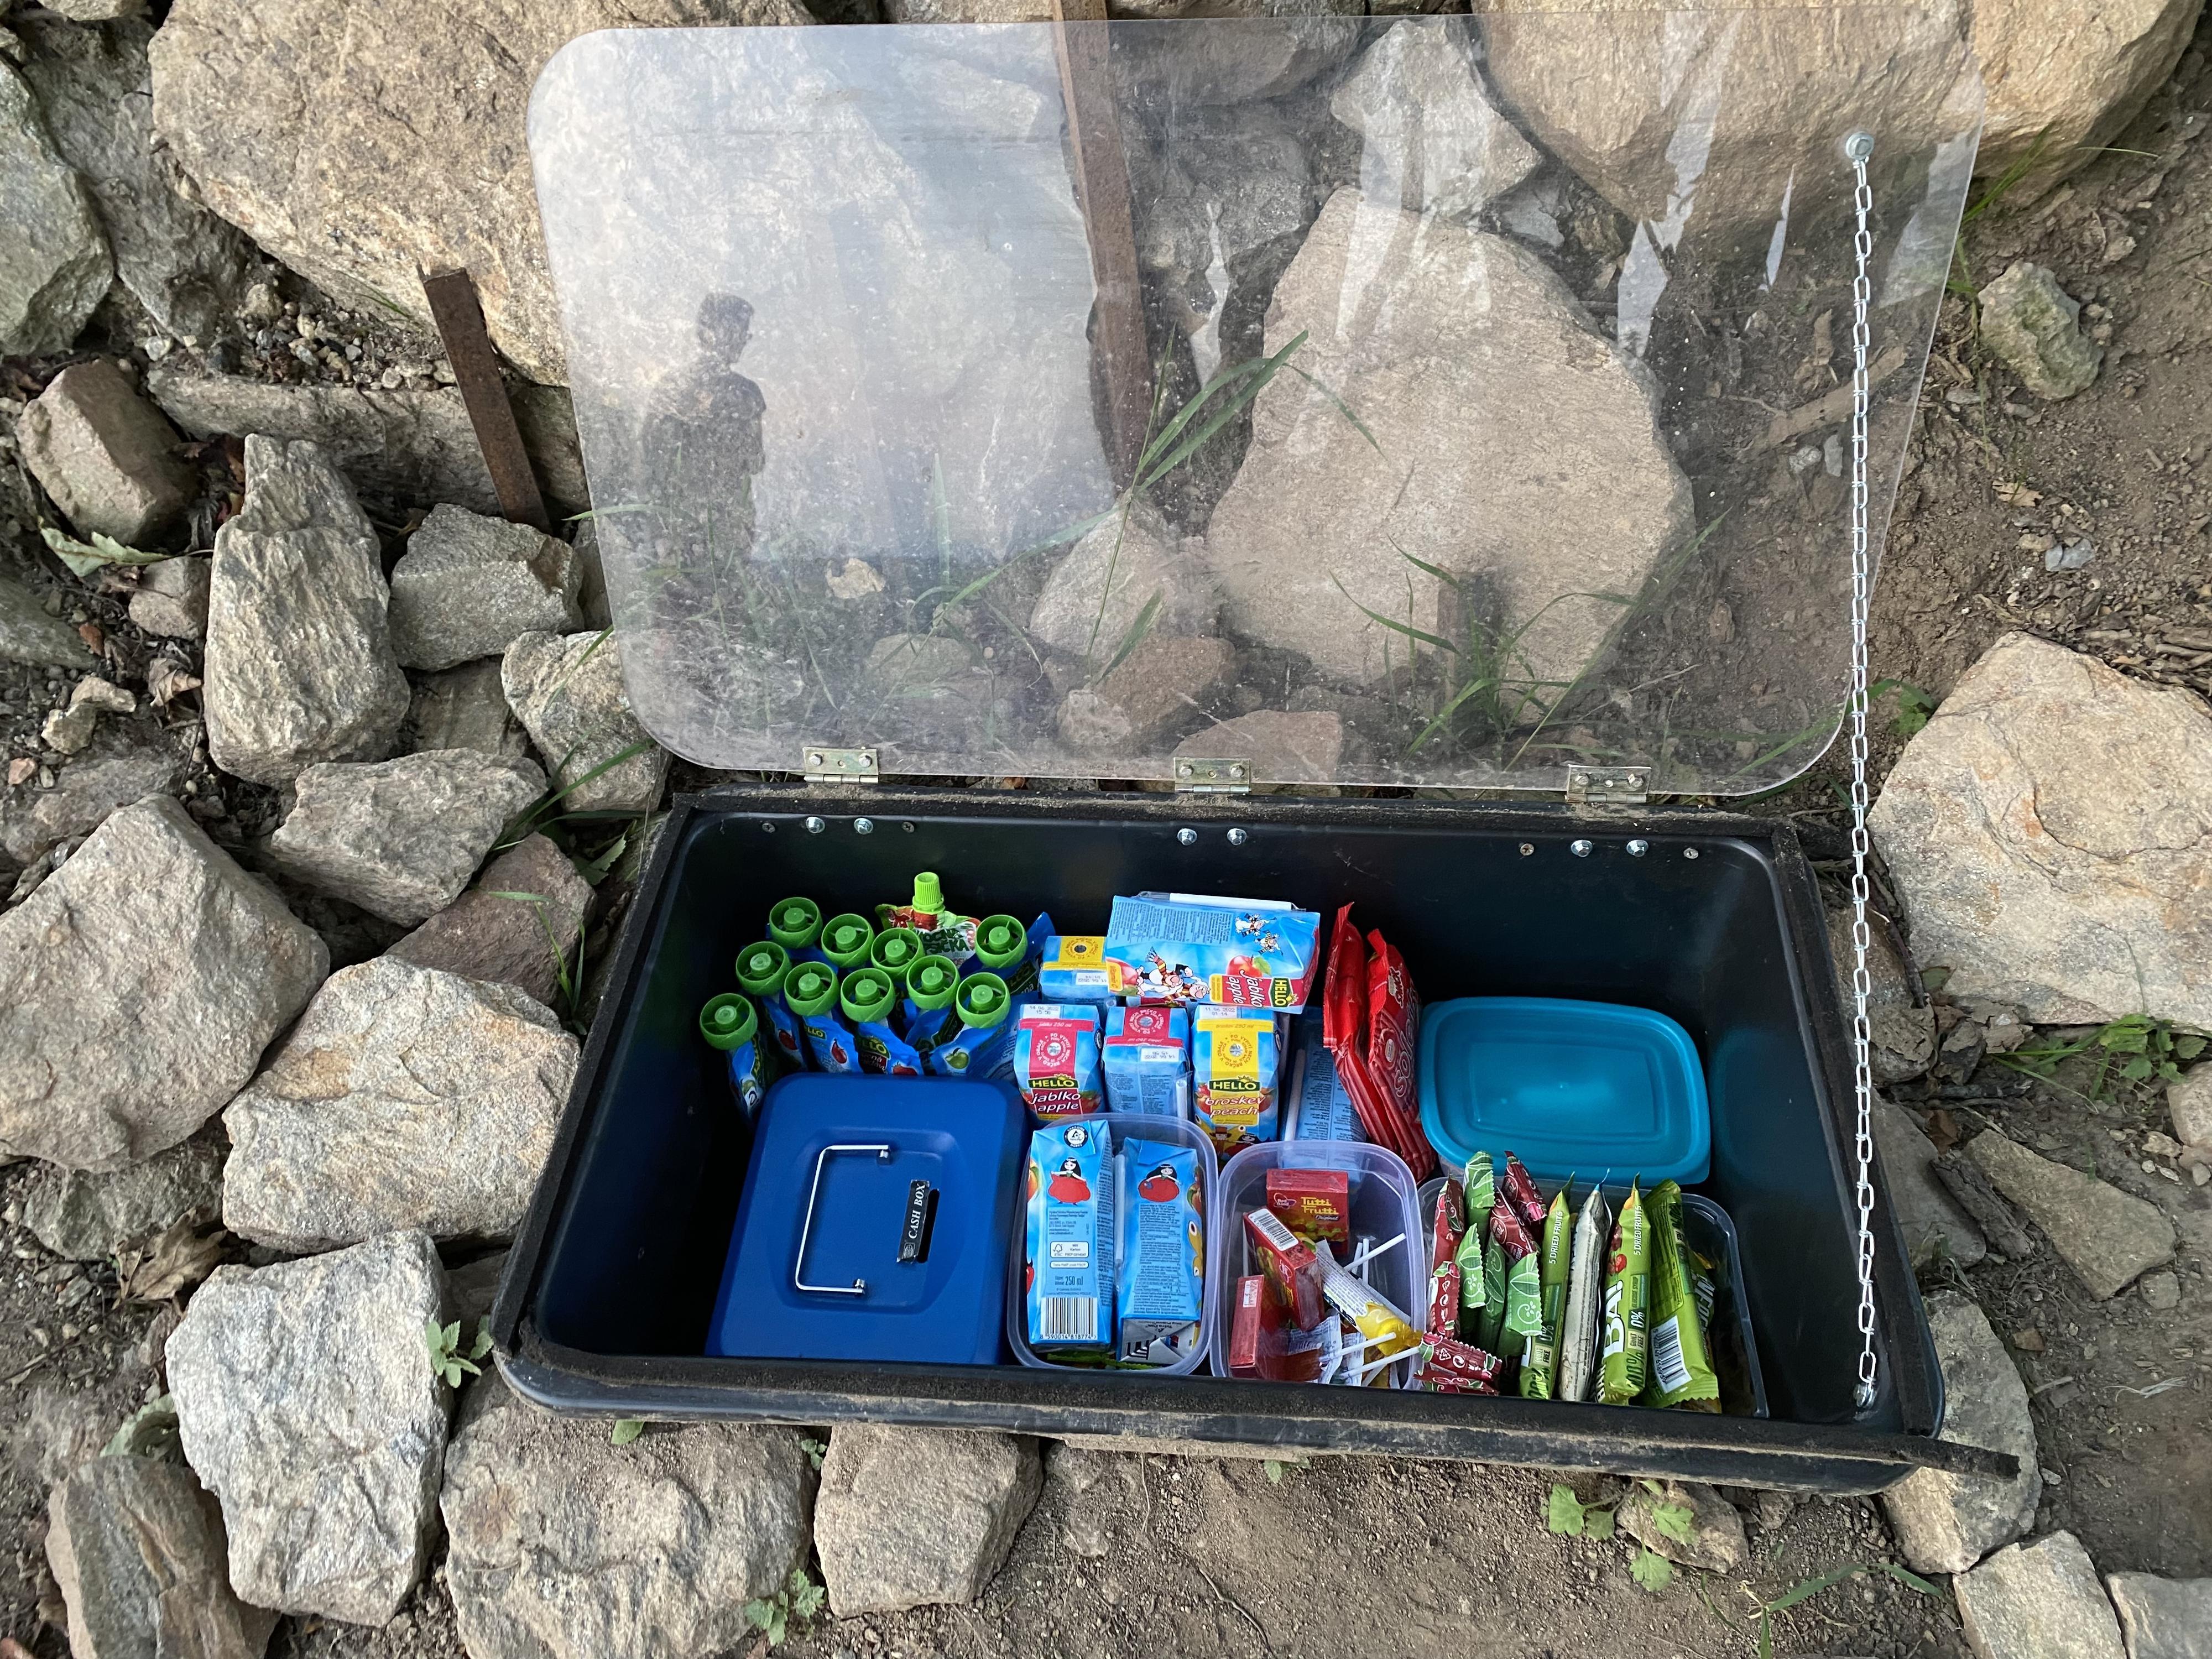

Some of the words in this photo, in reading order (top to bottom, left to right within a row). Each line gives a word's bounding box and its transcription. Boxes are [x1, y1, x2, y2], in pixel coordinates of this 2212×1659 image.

[1225, 977, 1246, 1004] apple
[1239, 969, 1265, 1007] jablko
[1274, 979, 1287, 1006] HELLO
[1213, 1082, 1256, 1090] HELLO
[1028, 1091, 1081, 1105] jablko
[1205, 1095, 1266, 1105] broskev
[1037, 1102, 1078, 1113] apple
[1210, 1107, 1259, 1118] peach
[914, 1183, 925, 1207] BOX
[1301, 1197, 1332, 1206] Tutti
[1301, 1206, 1339, 1214] Frutti
[908, 1211, 921, 1239] CASH
[1553, 1211, 1563, 1235] FRUITS
[1550, 1235, 1559, 1258] DRIED
[1065, 1276, 1075, 1285] 250
[1077, 1276, 1083, 1285] ml
[1603, 1280, 1624, 1360] BA!
[1631, 1311, 1645, 1328] 0%
[1540, 1325, 1554, 1342] 0%
